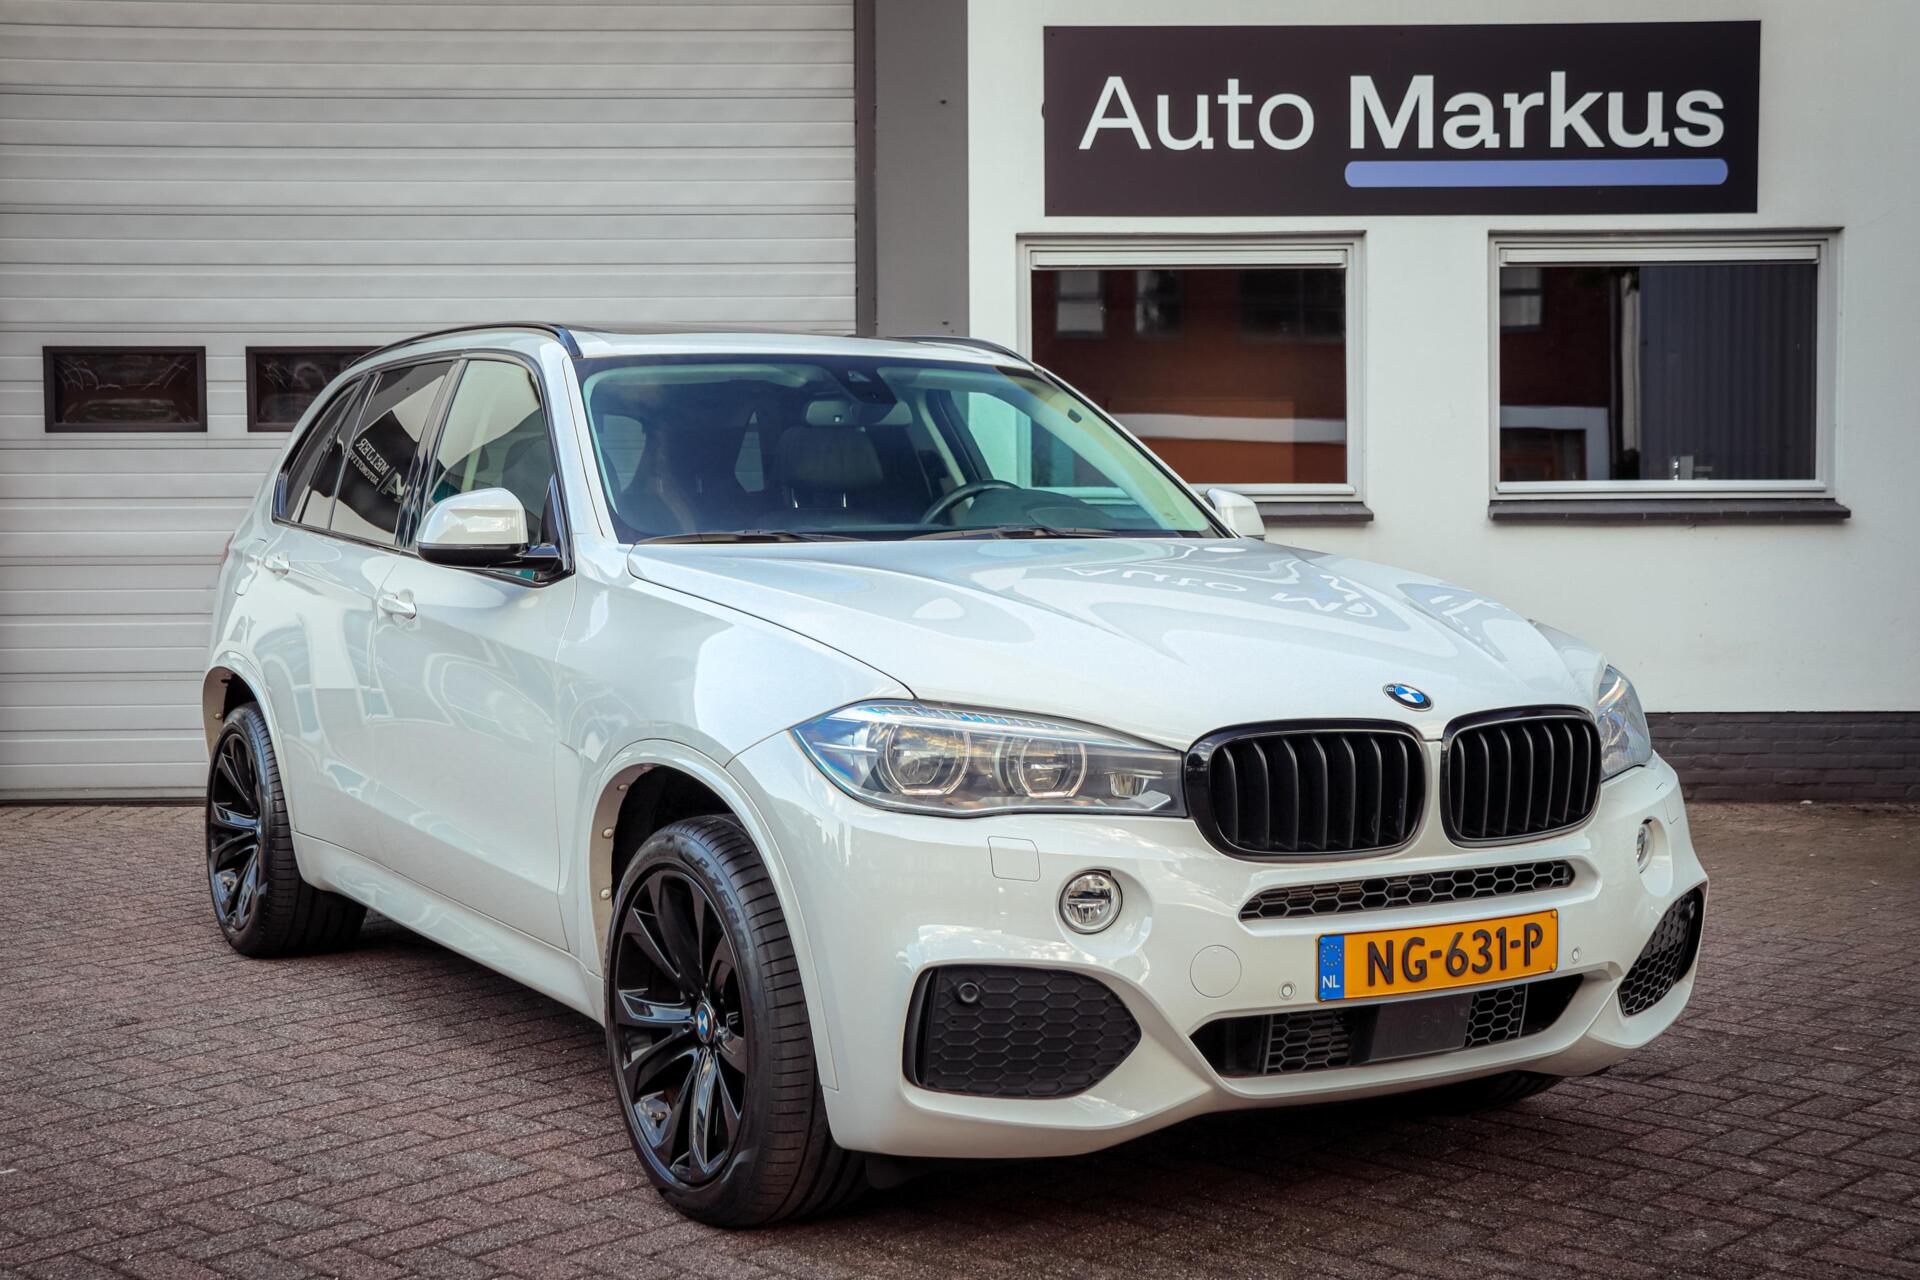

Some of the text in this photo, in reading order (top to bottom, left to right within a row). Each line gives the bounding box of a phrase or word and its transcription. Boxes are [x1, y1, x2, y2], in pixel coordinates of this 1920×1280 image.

[1078, 70, 1725, 151] Auto Markus
[1322, 975, 1341, 989] NL
[1367, 922, 1544, 987] NG-631-P
